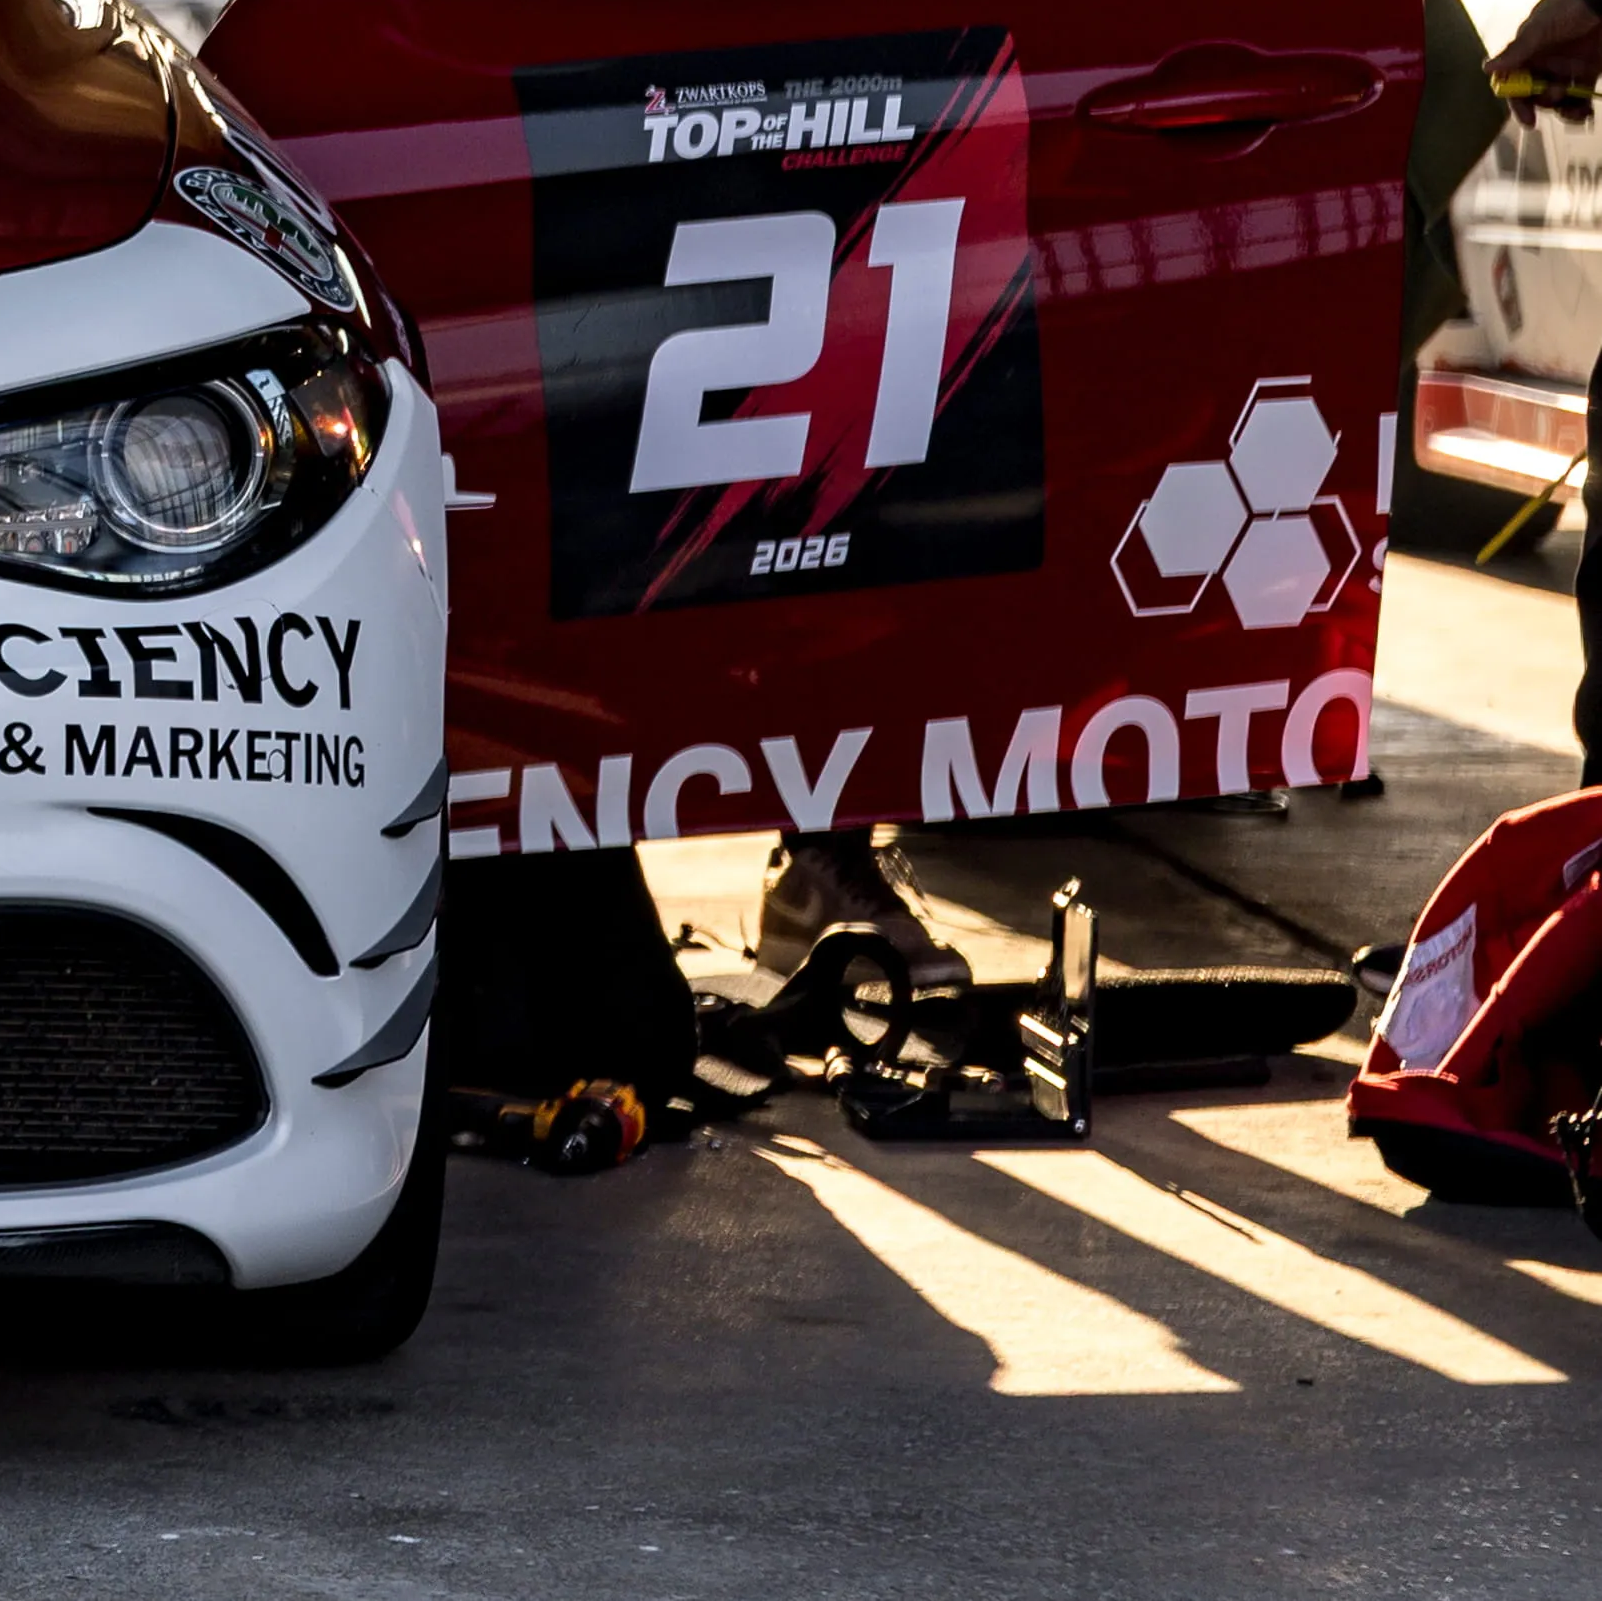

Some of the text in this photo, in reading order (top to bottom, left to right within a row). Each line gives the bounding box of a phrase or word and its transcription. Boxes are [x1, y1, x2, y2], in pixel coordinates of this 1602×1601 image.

[675, 79, 766, 103] ZWARTKOPS
[784, 74, 903, 99] THE 2000m
[643, 94, 916, 164] TOP OF THE HILL
[781, 142, 908, 172] CHALLENGE
[629, 196, 967, 495] 21
[748, 532, 851, 576] 2026
[63, 722, 366, 789] MARKETING
